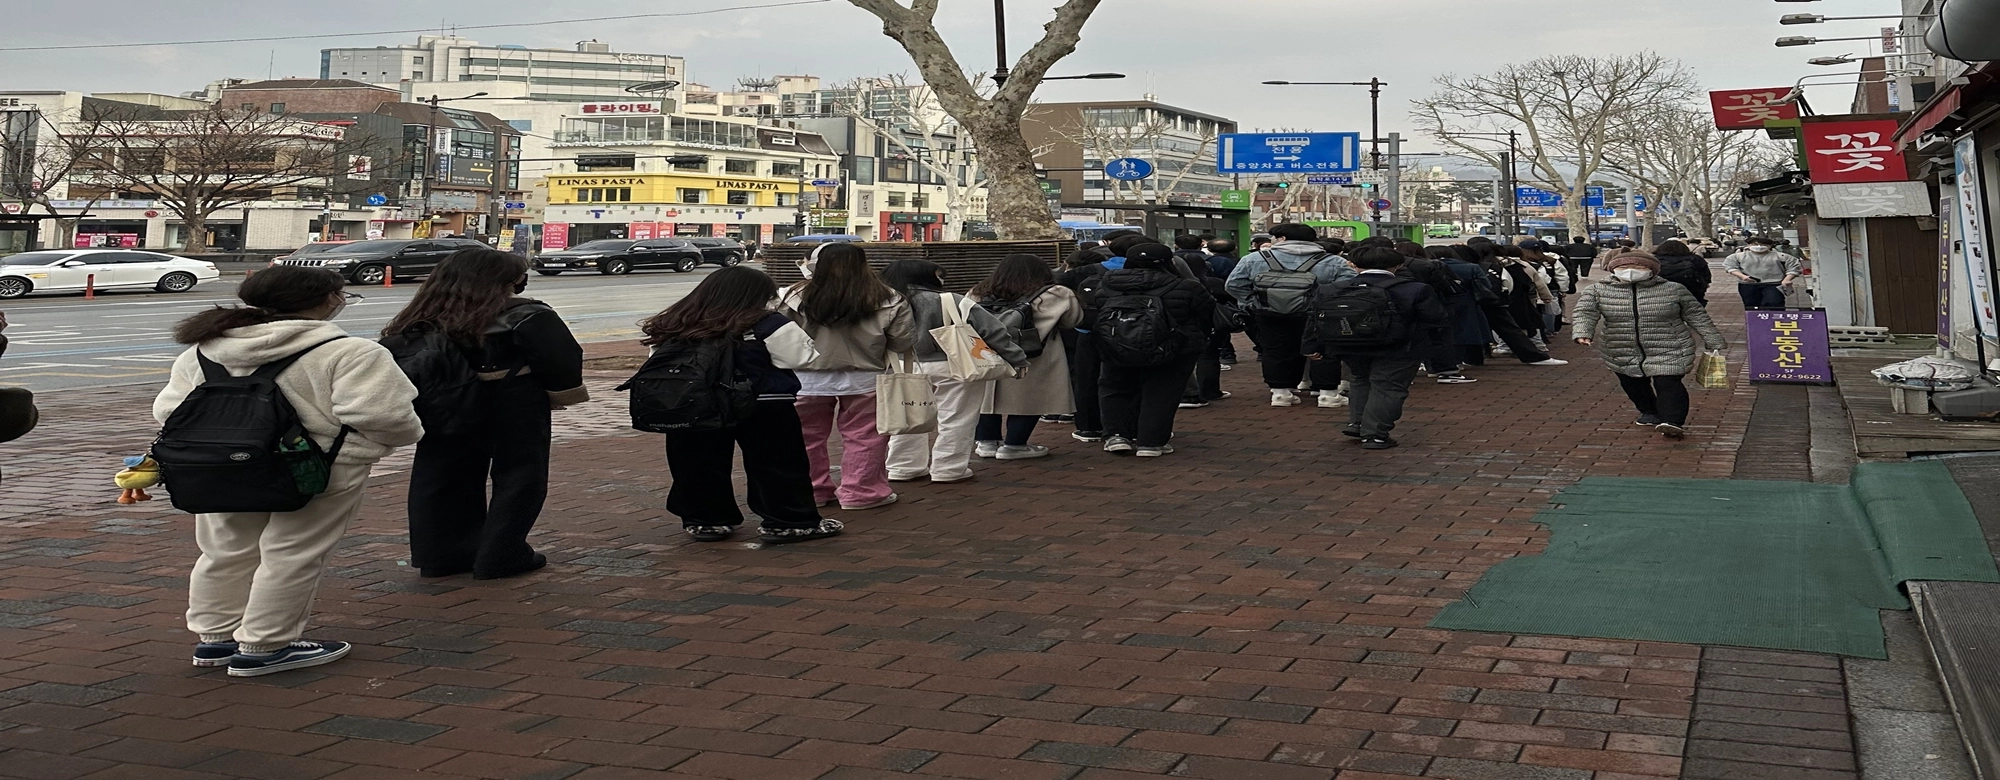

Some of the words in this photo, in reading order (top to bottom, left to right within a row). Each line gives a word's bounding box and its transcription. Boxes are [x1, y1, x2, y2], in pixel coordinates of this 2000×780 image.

[1721, 91, 1788, 123] 꽃
[1271, 146, 1304, 154] 전용
[1815, 131, 1893, 173] 꽃
[558, 178, 598, 186] LINAS
[716, 180, 747, 189] LINAS
[750, 182, 779, 190] PASTA
[1770, 320, 1806, 368] 부동산
